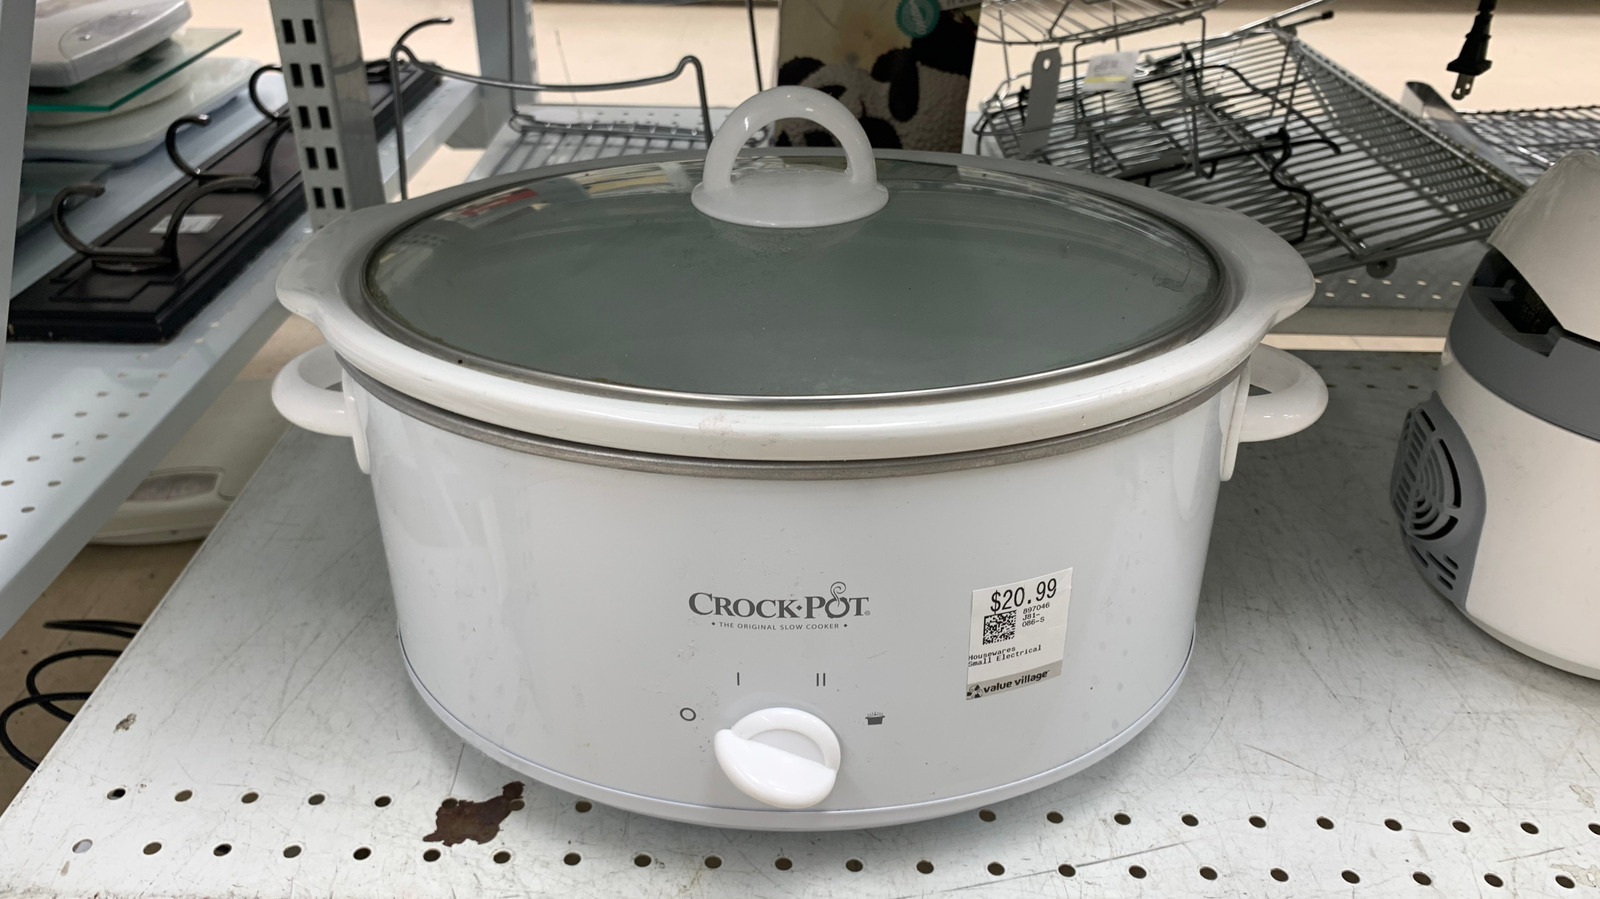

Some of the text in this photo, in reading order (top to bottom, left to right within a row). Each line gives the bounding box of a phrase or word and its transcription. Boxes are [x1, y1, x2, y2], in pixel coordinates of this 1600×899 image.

[990, 578, 1057, 615] $20.99
[1022, 602, 1050, 614] 897046
[719, 621, 840, 631] THE ORIGINAL SLOW COOKER
[967, 644, 1042, 668] Small Electrical
[968, 646, 1016, 661] Housewares
[983, 670, 1049, 694] value village
